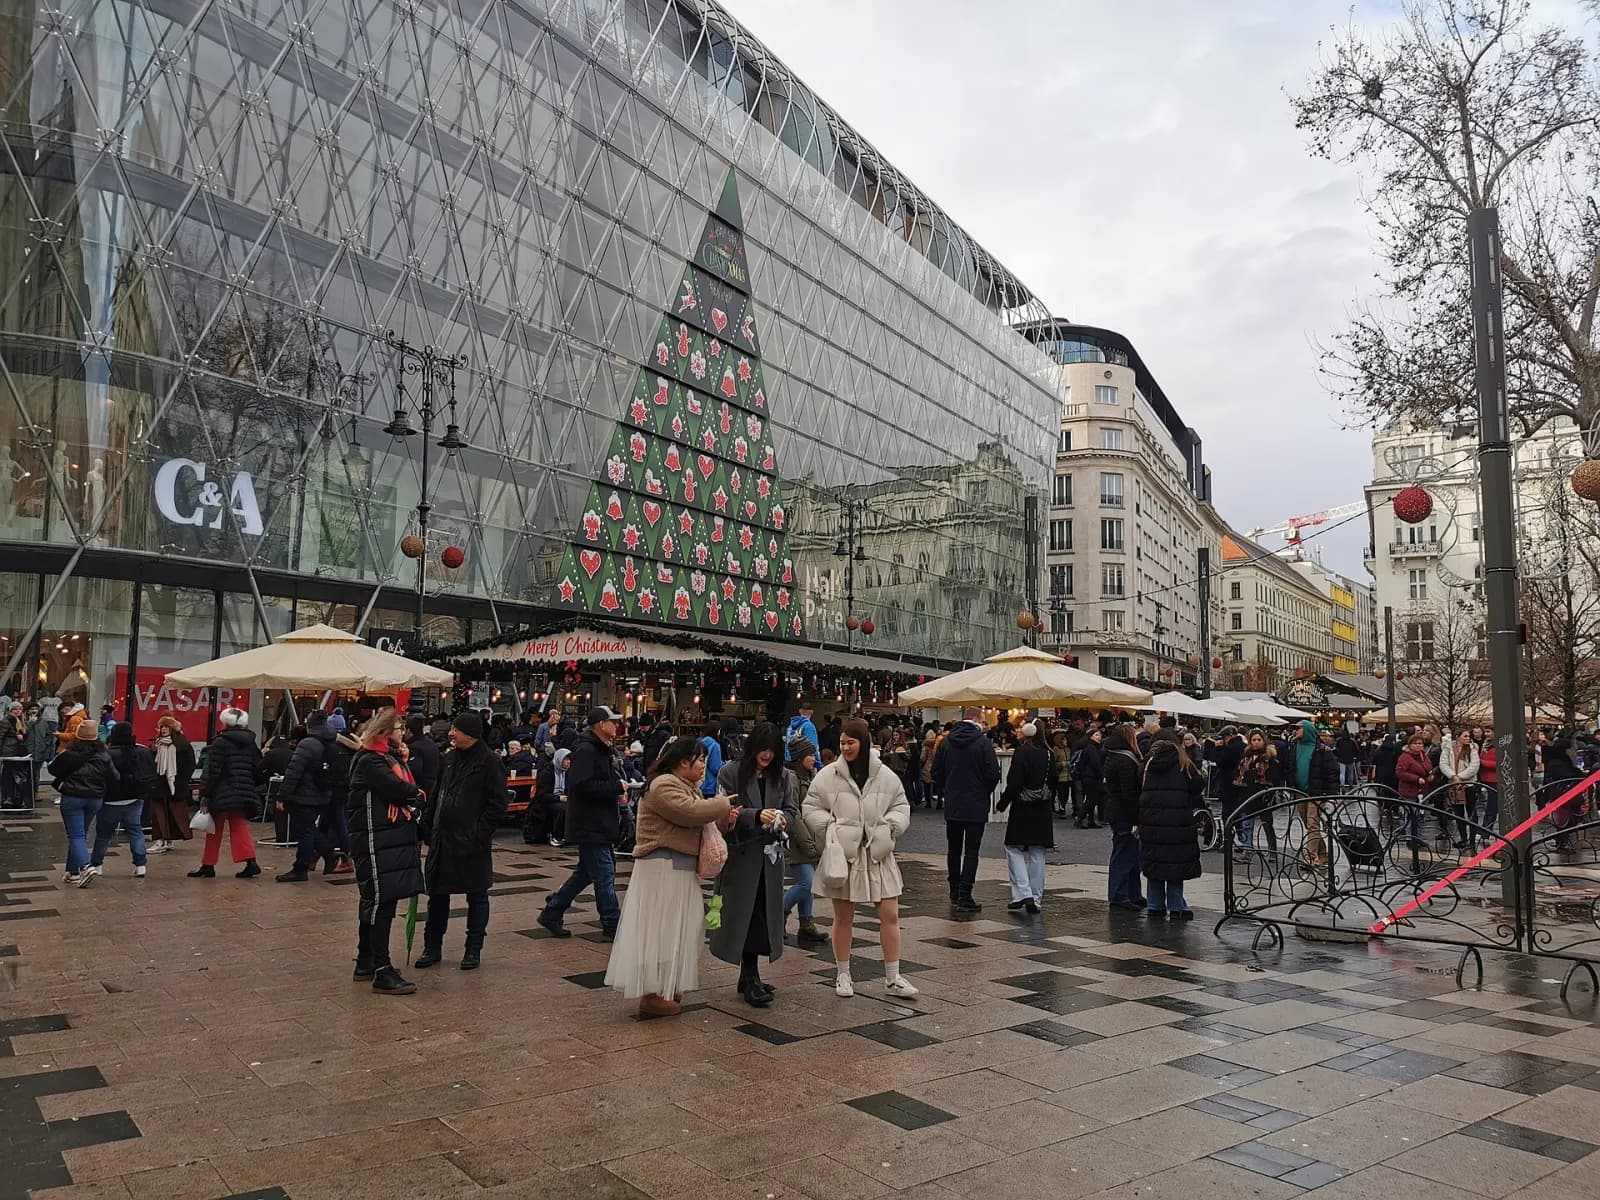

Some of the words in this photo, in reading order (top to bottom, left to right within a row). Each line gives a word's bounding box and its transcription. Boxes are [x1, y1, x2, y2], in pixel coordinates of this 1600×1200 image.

[154, 457, 265, 536] C&A
[375, 636, 406, 656] C&A
[523, 640, 559, 657] Merry
[564, 636, 628, 655] Christmas
